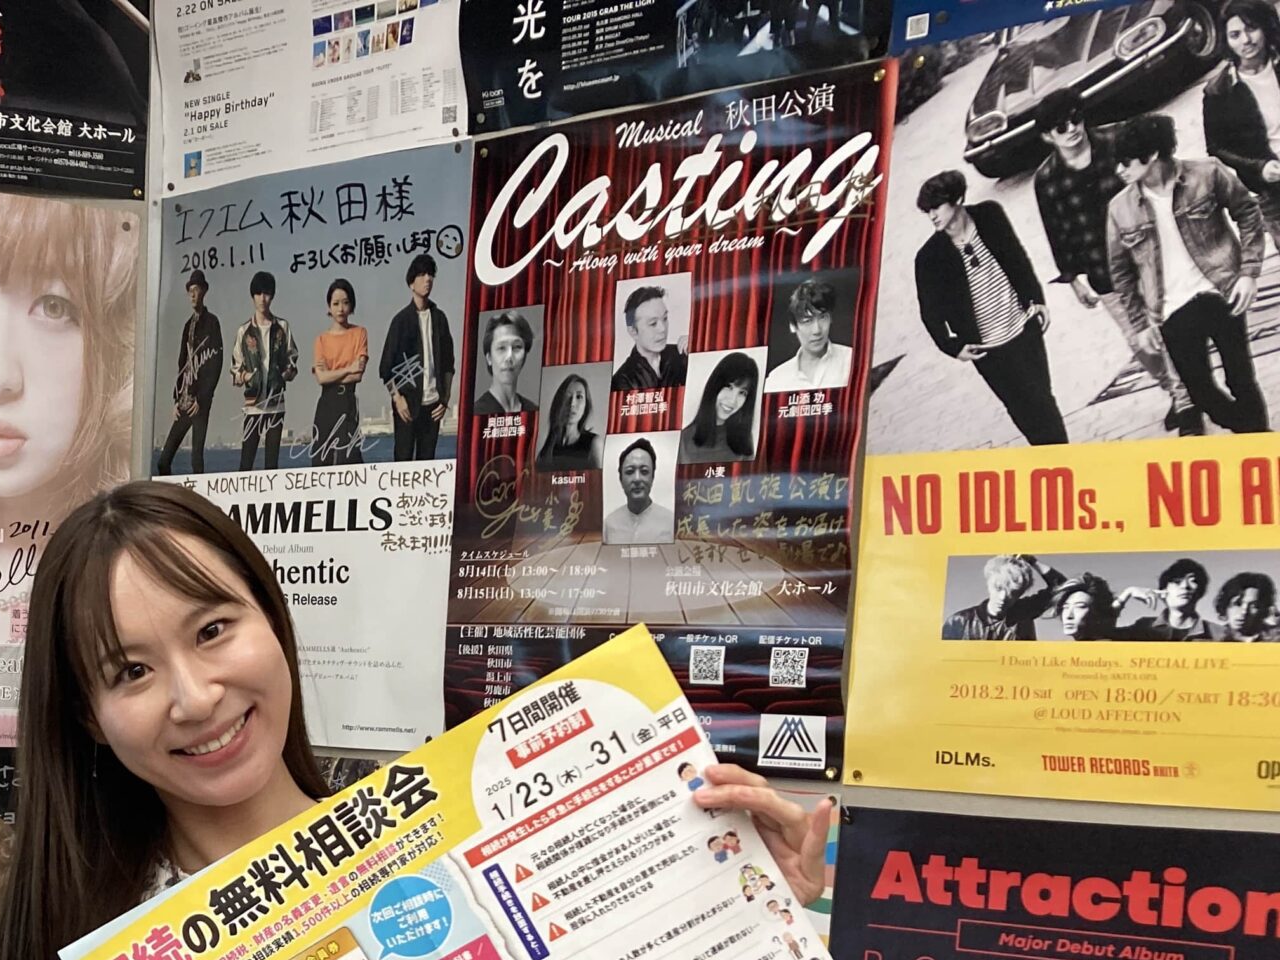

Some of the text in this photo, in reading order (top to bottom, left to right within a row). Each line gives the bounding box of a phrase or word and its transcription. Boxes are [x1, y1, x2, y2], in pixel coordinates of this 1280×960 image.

[176, 4, 197, 18] 2.22
[562, 3, 633, 23] TOUR 2015 GRAB THE
[184, 92, 230, 109] NEW SINGLE
[724, 83, 836, 131] 秋田公演
[78, 121, 136, 143] 大ホール
[197, 120, 229, 133] ON SALE
[615, 110, 704, 149] Musical
[279, 175, 415, 234] 秋田様
[474, 131, 884, 287] Casting
[180, 228, 438, 274] 2018.1.11 よろしくお願いします
[622, 241, 659, 266] with
[665, 239, 703, 266] your
[207, 467, 368, 497] MONTHLY SELECTION
[552, 473, 586, 484] kasumi
[704, 466, 726, 478] 小麦
[395, 492, 449, 511] ありがとう
[882, 472, 942, 536] NO
[1147, 459, 1221, 529] NO
[262, 544, 314, 554] Debut Album
[460, 550, 530, 561] タイムスケジュール
[665, 580, 838, 597] 秋田市文化会館 大ホール
[292, 593, 338, 606] Release
[678, 634, 739, 645] 一般チケットQR
[758, 635, 823, 646] 配信チケットQR
[486, 658, 512, 669] 秋田市
[1000, 655, 1007, 667] I
[1008, 654, 1039, 668] Don't
[1041, 655, 1068, 669] Like
[1129, 658, 1189, 670] SPECIAL
[1194, 658, 1230, 670] LIVE
[484, 685, 511, 695] 男鹿市
[949, 684, 1031, 701] 2018.2.10
[1032, 685, 1053, 700] sat
[1064, 689, 1099, 702] OPEN
[1104, 688, 1158, 704] 18:00
[1176, 692, 1220, 705] START
[487, 681, 582, 744] 7日間開催
[1050, 708, 1182, 723] LOUD AFFECTION
[517, 712, 586, 761] 事前予約制
[935, 750, 996, 768] IDLMs.
[1041, 754, 1151, 777] TOWER RECORDS
[485, 776, 512, 796] 2025
[871, 849, 1280, 939] Attraction
[371, 888, 445, 924] 次回ご相談時に
[398, 909, 429, 929] ご利用
[999, 931, 1051, 955] Major
[1056, 938, 1116, 960] Debut
